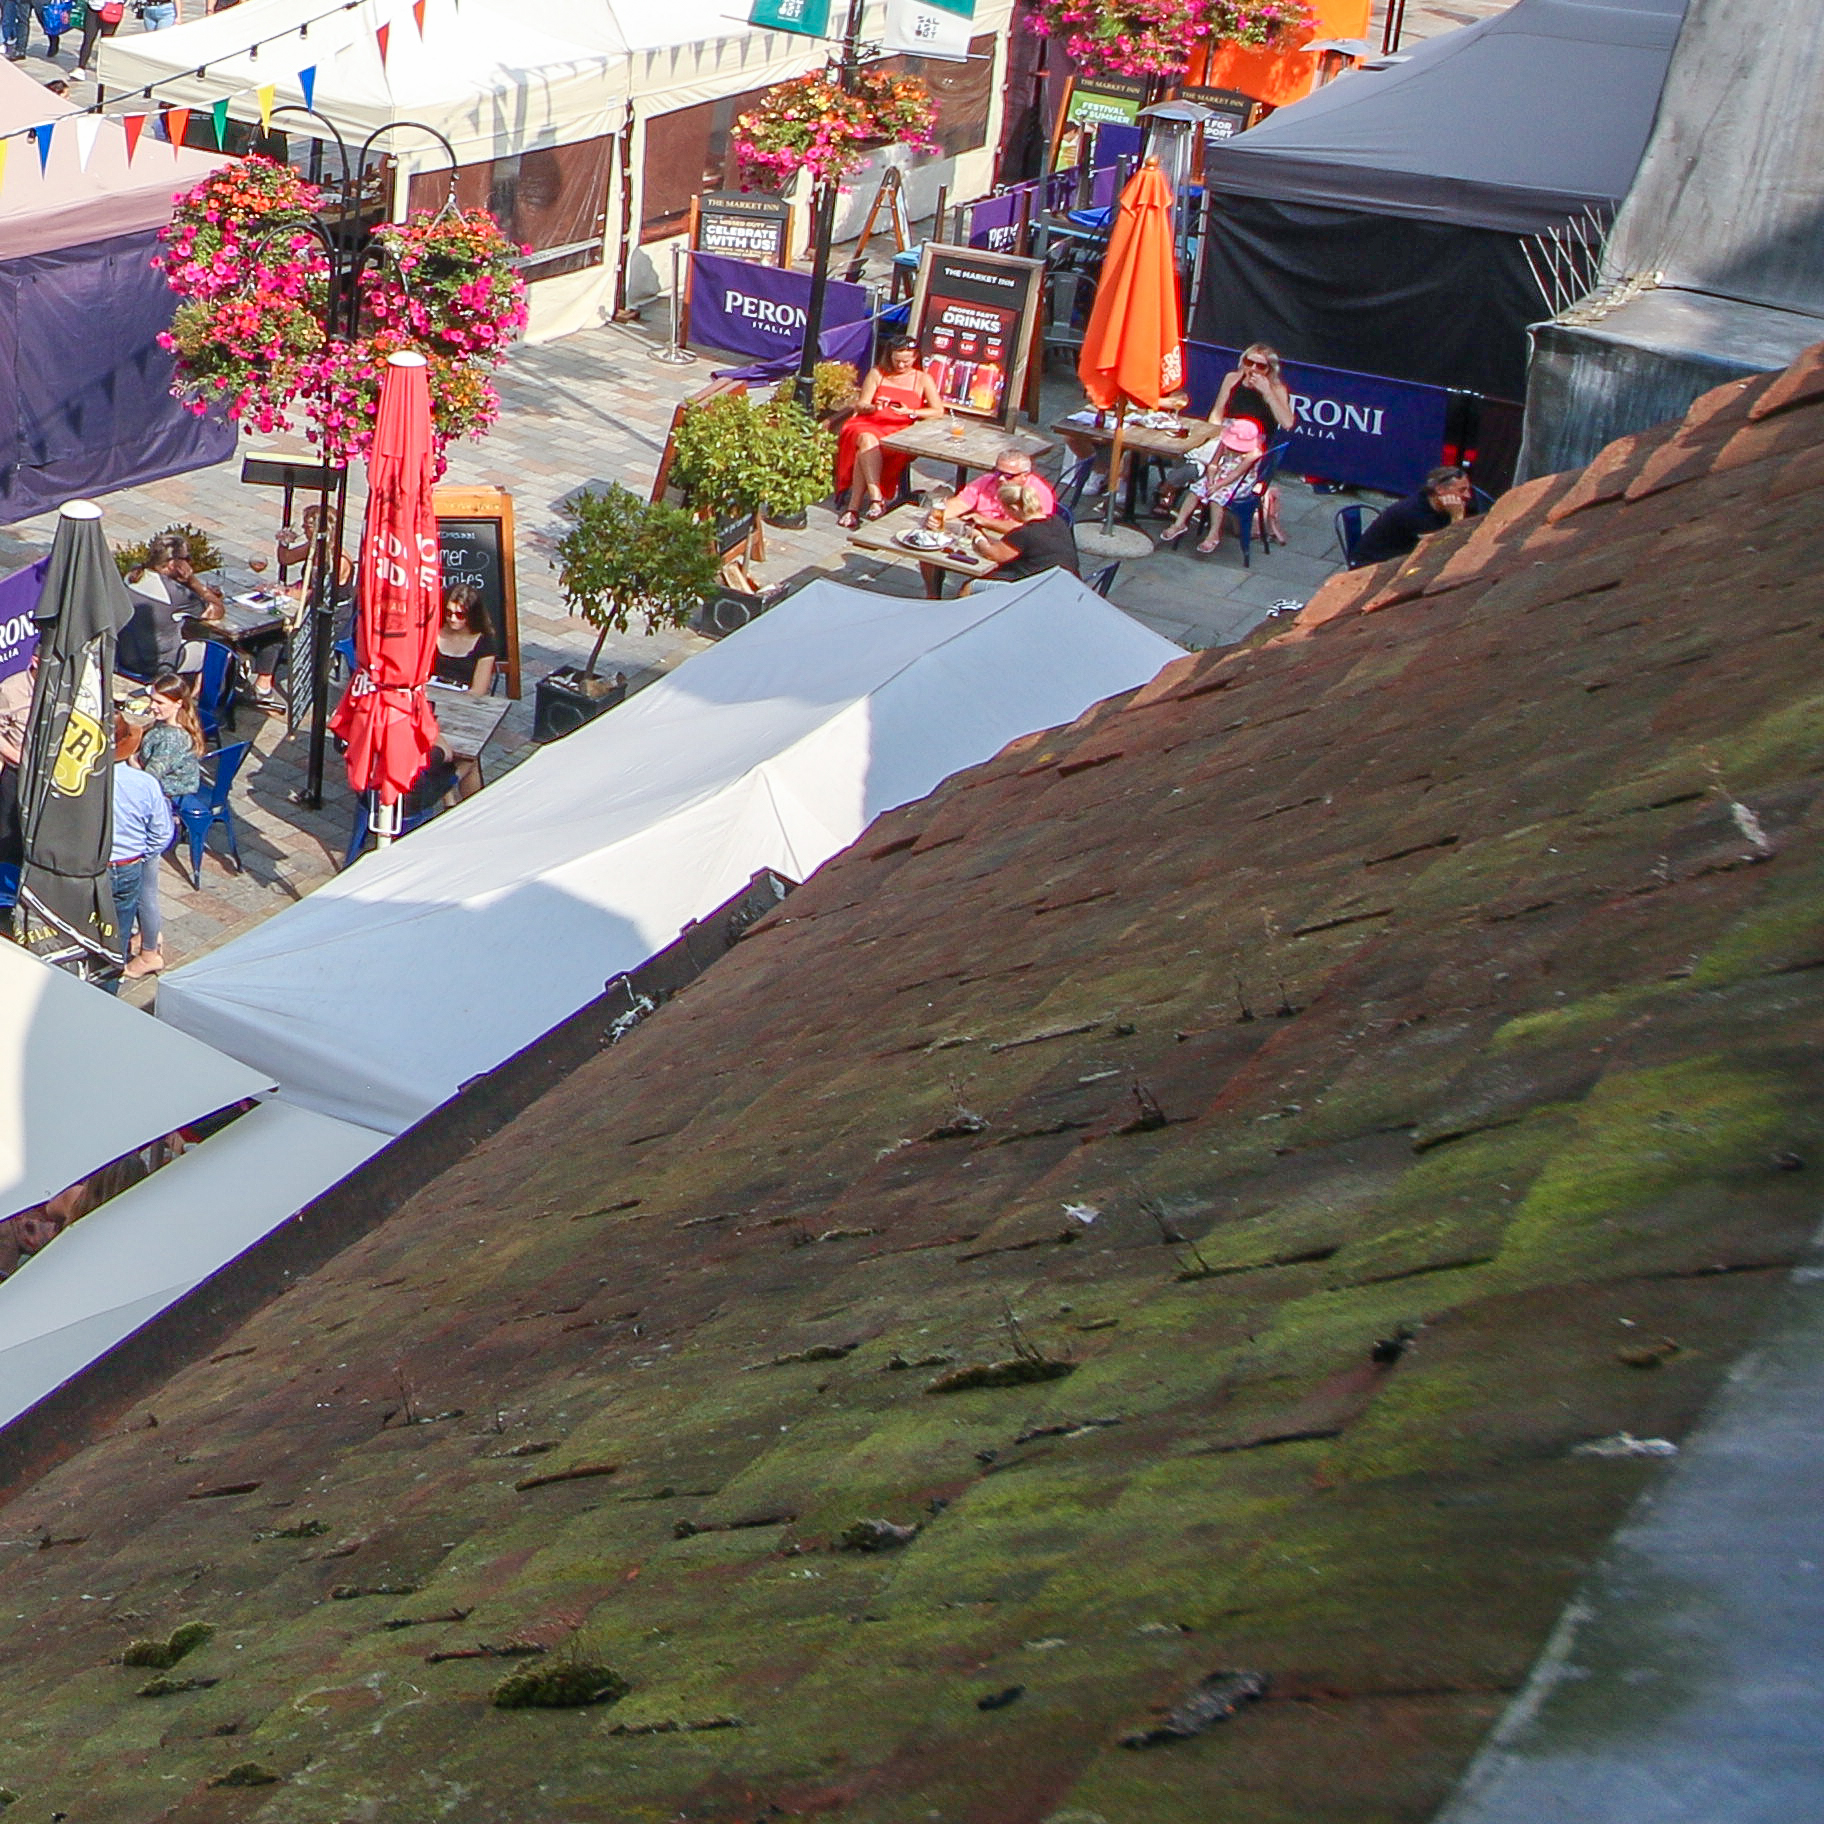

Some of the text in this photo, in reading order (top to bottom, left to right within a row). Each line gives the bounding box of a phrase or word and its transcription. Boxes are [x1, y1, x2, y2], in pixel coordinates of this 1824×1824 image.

[1080, 79, 1141, 95] THE MARKET INN
[1182, 91, 1245, 108] THE MARKET INN
[1075, 107, 1131, 124] OF SUMMER
[1082, 101, 1126, 117] FESTIVAL
[1203, 127, 1234, 139] PORT
[1211, 120, 1233, 132] FOR
[707, 199, 781, 213] THE MARKET INN
[706, 224, 777, 240] CELEBRATE
[705, 234, 777, 252] WITH US!
[944, 267, 1015, 288] THE MARKET INN
[724, 289, 808, 329] PERON
[752, 321, 792, 337] ITALIA
[941, 311, 1002, 334] DRINKS
[1289, 393, 1385, 436] RONI
